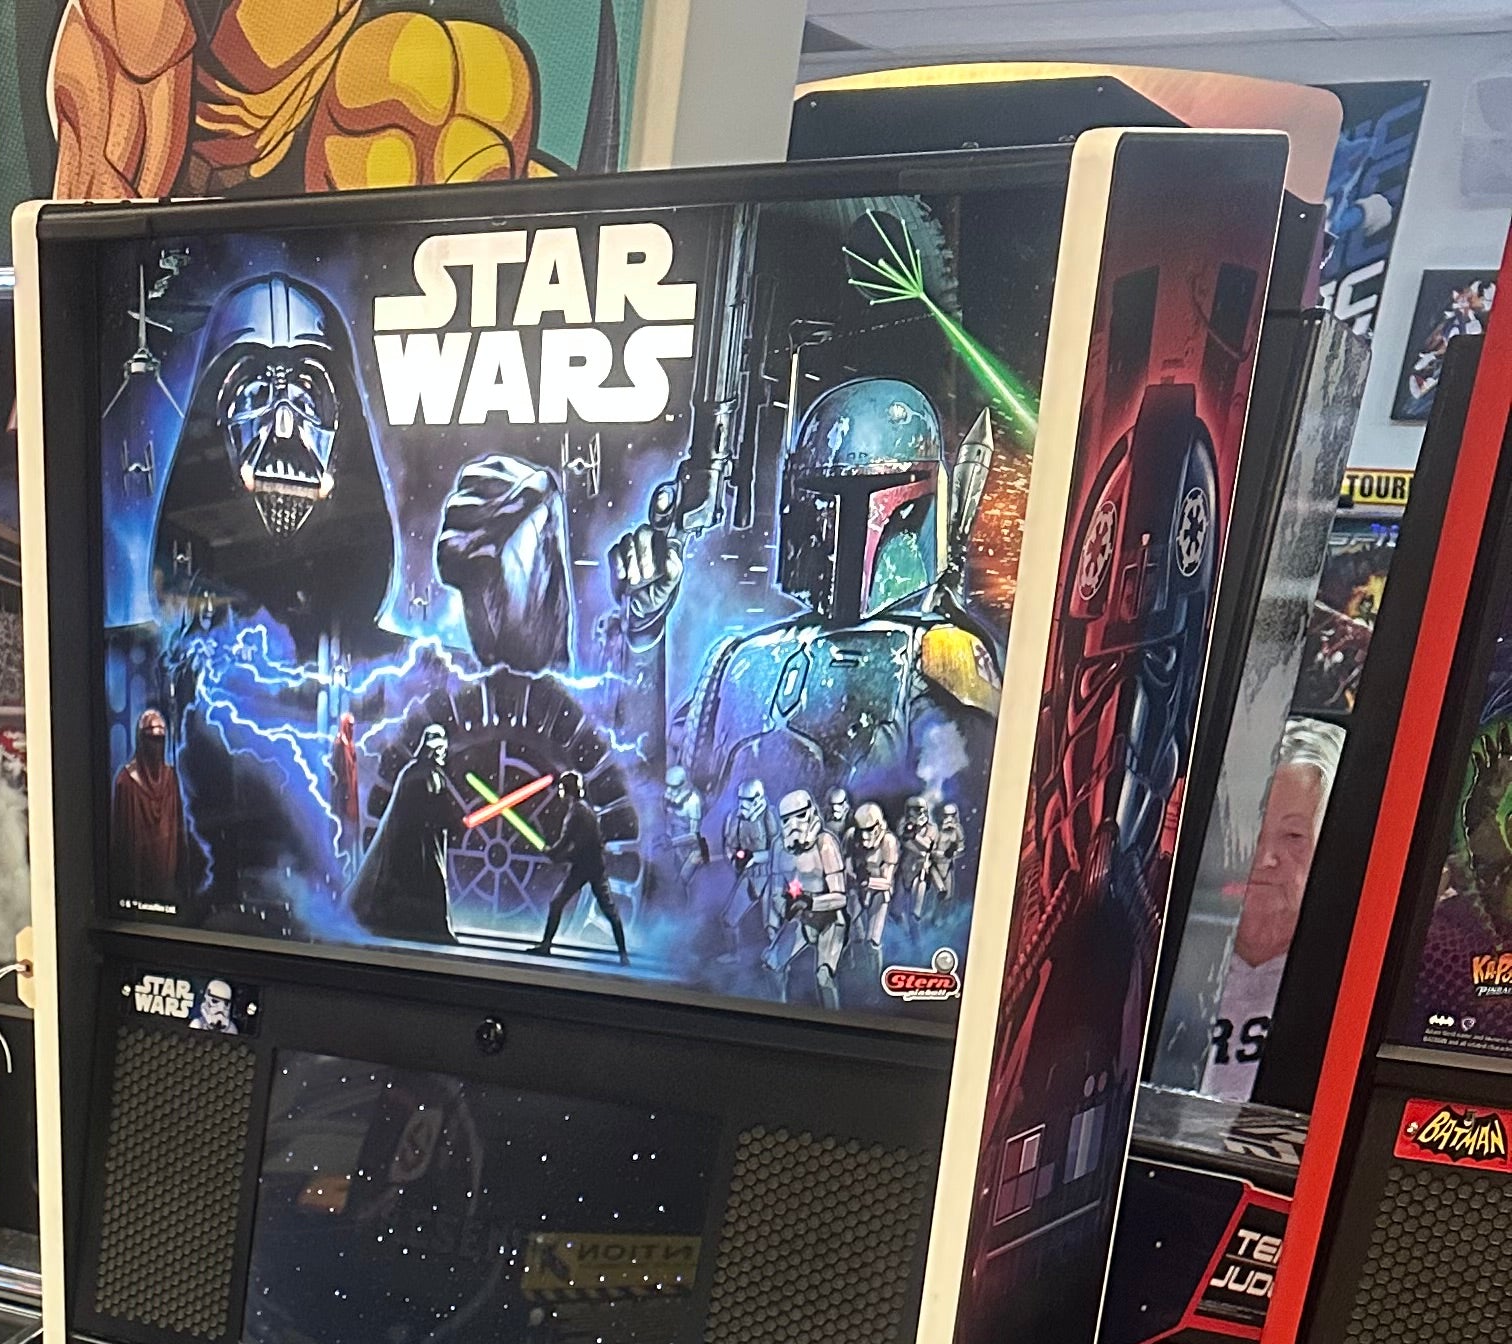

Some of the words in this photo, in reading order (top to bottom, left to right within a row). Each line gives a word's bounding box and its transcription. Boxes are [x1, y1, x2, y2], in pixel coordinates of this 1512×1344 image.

[374, 223, 697, 330] STAR
[372, 323, 694, 426] WARS
[1346, 474, 1414, 501] TOUR
[135, 975, 195, 1000] STAR
[884, 970, 954, 997] Stern
[135, 992, 194, 1019] WARS
[1418, 1110, 1505, 1157] BATMAN
[1238, 1229, 1284, 1264] TE
[1210, 1263, 1275, 1298] JUD
